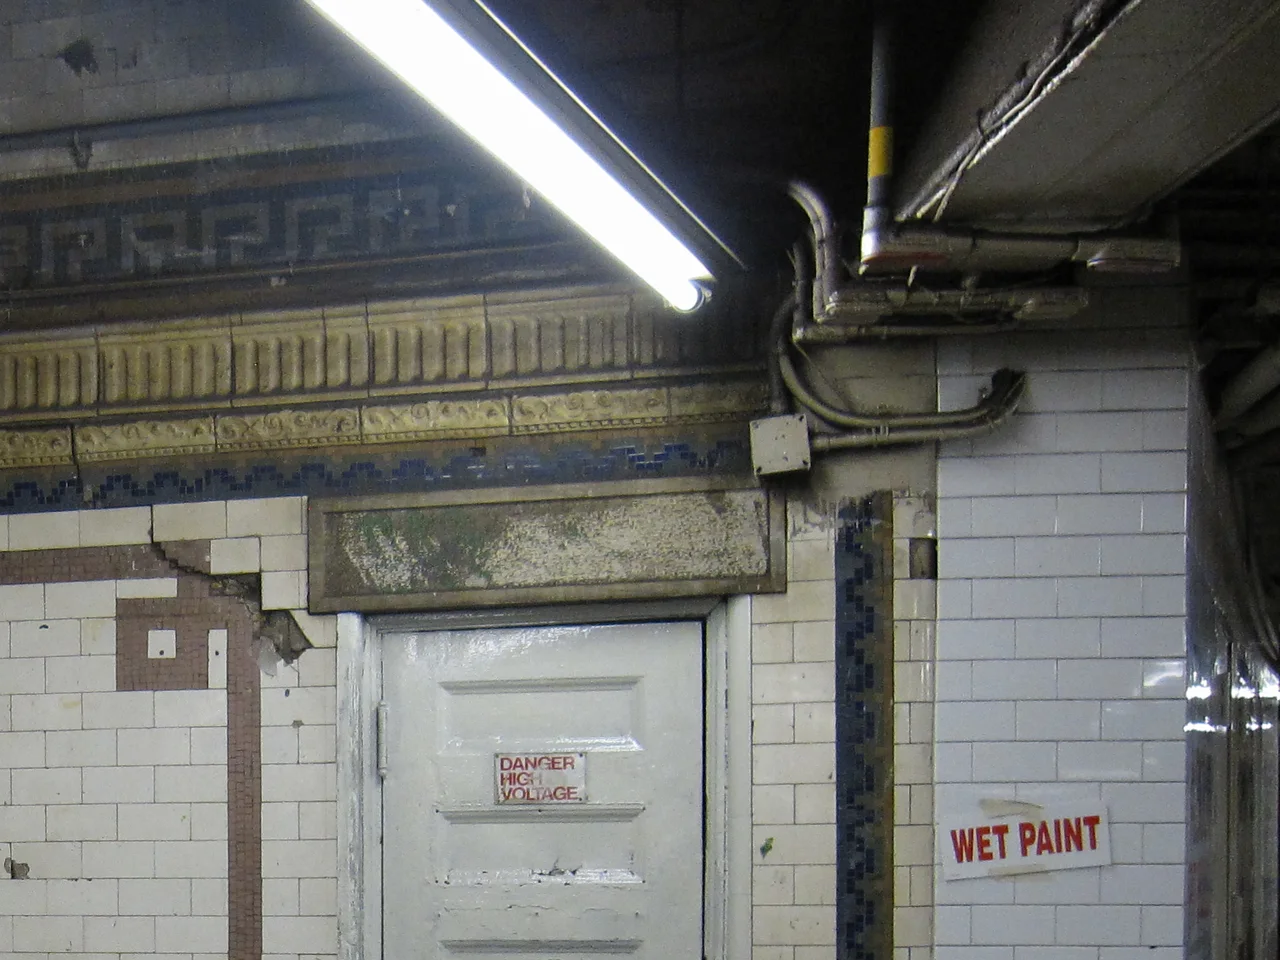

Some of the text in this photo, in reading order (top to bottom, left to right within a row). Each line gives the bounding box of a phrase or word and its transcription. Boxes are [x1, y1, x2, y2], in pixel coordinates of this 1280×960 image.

[500, 756, 575, 771] DANGER
[500, 771, 543, 787] HIGH
[500, 786, 579, 801] VOLTAGE
[950, 815, 1101, 864] WET PAINT
